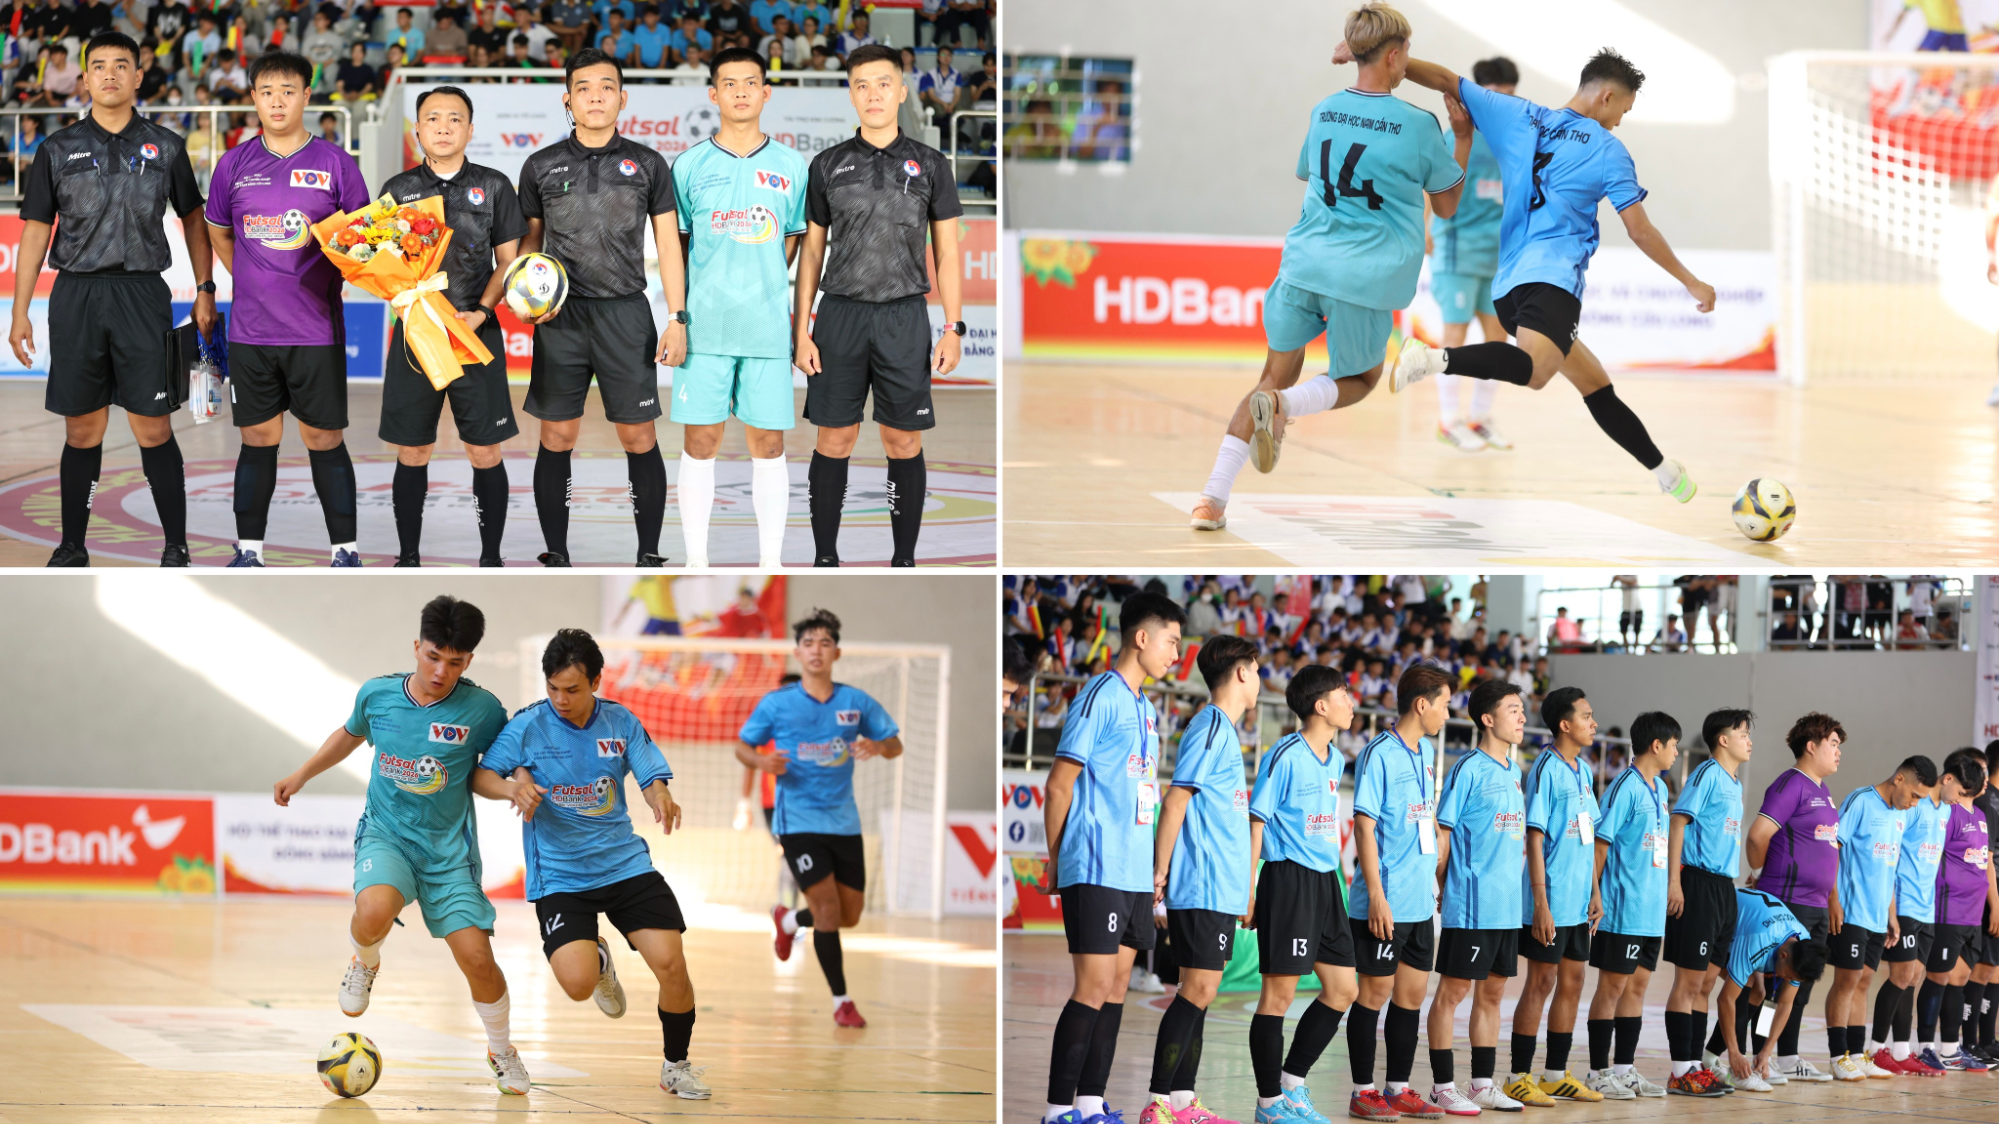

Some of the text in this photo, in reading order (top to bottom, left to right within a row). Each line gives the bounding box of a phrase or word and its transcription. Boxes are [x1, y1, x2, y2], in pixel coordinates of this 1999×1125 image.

[615, 114, 679, 136] utsal
[500, 132, 544, 148] VOV
[293, 171, 330, 187] VOV
[757, 171, 791, 191] VOV
[1320, 138, 1384, 211] 14
[243, 214, 283, 226] Futsal
[1093, 275, 1268, 328] HDBan
[678, 383, 688, 403] 4
[432, 724, 469, 742] VOV
[379, 752, 418, 770] Futsal
[552, 783, 594, 795] Futsal
[362, 858, 373, 872] 8
[796, 853, 813, 874] 10
[1107, 912, 1118, 933] 8
[1218, 933, 1228, 950] 9
[1292, 938, 1308, 957] 13
[1699, 941, 1708, 956] 6
[1903, 934, 1915, 949] 10
[1376, 943, 1394, 961] 14
[1470, 945, 1480, 963] 7
[1625, 943, 1640, 960] 12
[1851, 944, 1859, 958] 5
